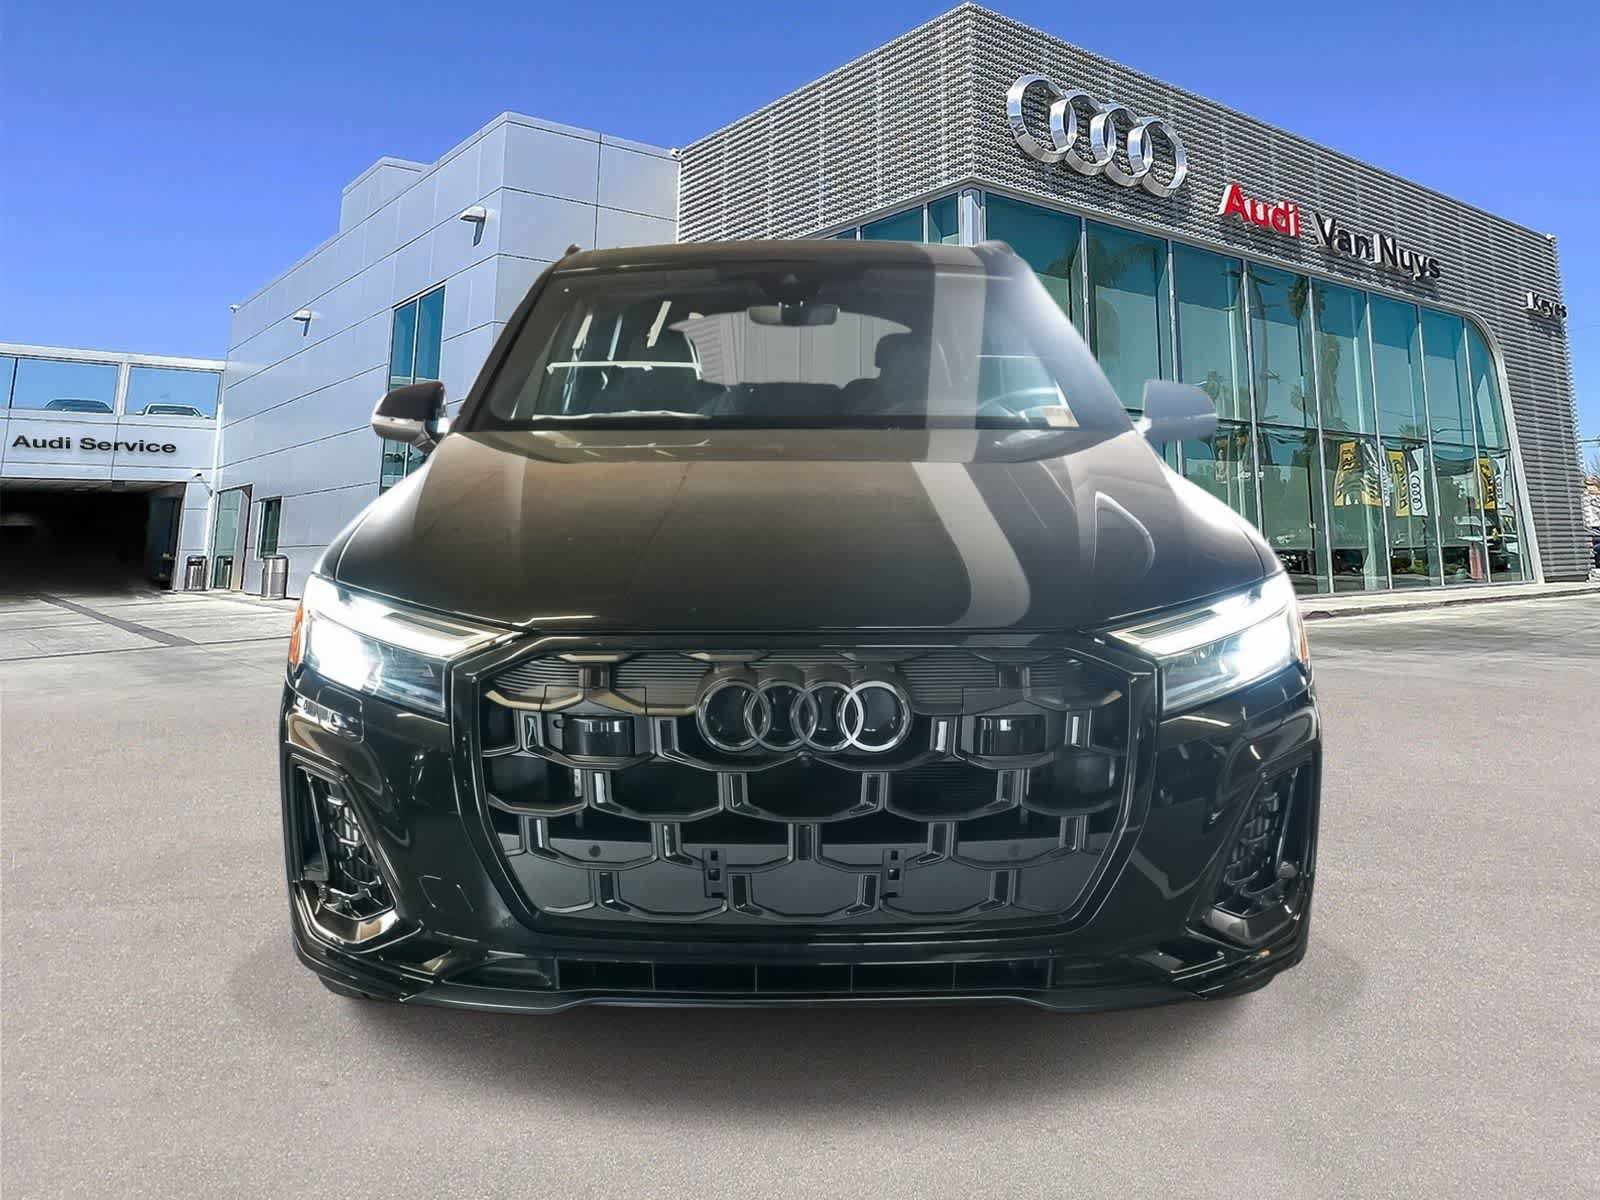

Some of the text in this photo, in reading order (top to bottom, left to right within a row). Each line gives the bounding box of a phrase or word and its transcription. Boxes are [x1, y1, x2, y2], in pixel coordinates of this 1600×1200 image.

[1218, 182, 1441, 281] Audi Van Nuys
[12, 435, 177, 454] Audi Service
